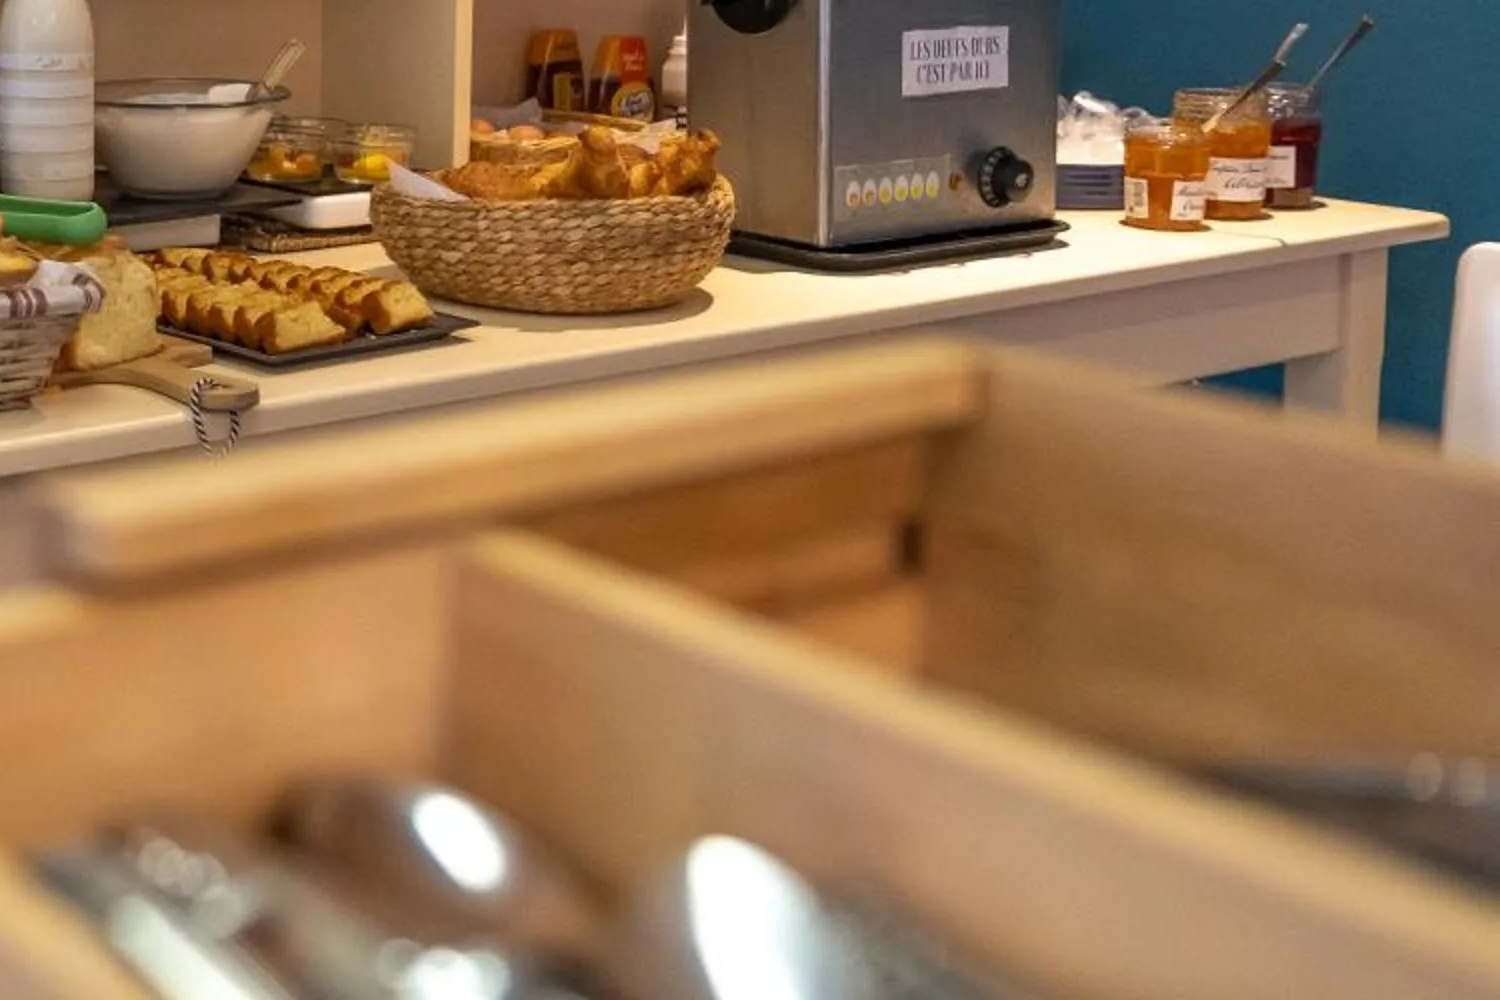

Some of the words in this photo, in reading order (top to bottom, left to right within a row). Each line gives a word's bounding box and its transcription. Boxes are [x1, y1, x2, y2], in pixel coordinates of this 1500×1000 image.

[909, 39, 931, 61] LES
[933, 37, 968, 59] OEUFS
[971, 35, 1000, 57] DURS
[916, 62, 947, 84] C'EST
[949, 60, 972, 82] PAR
[975, 59, 989, 81] ICI
